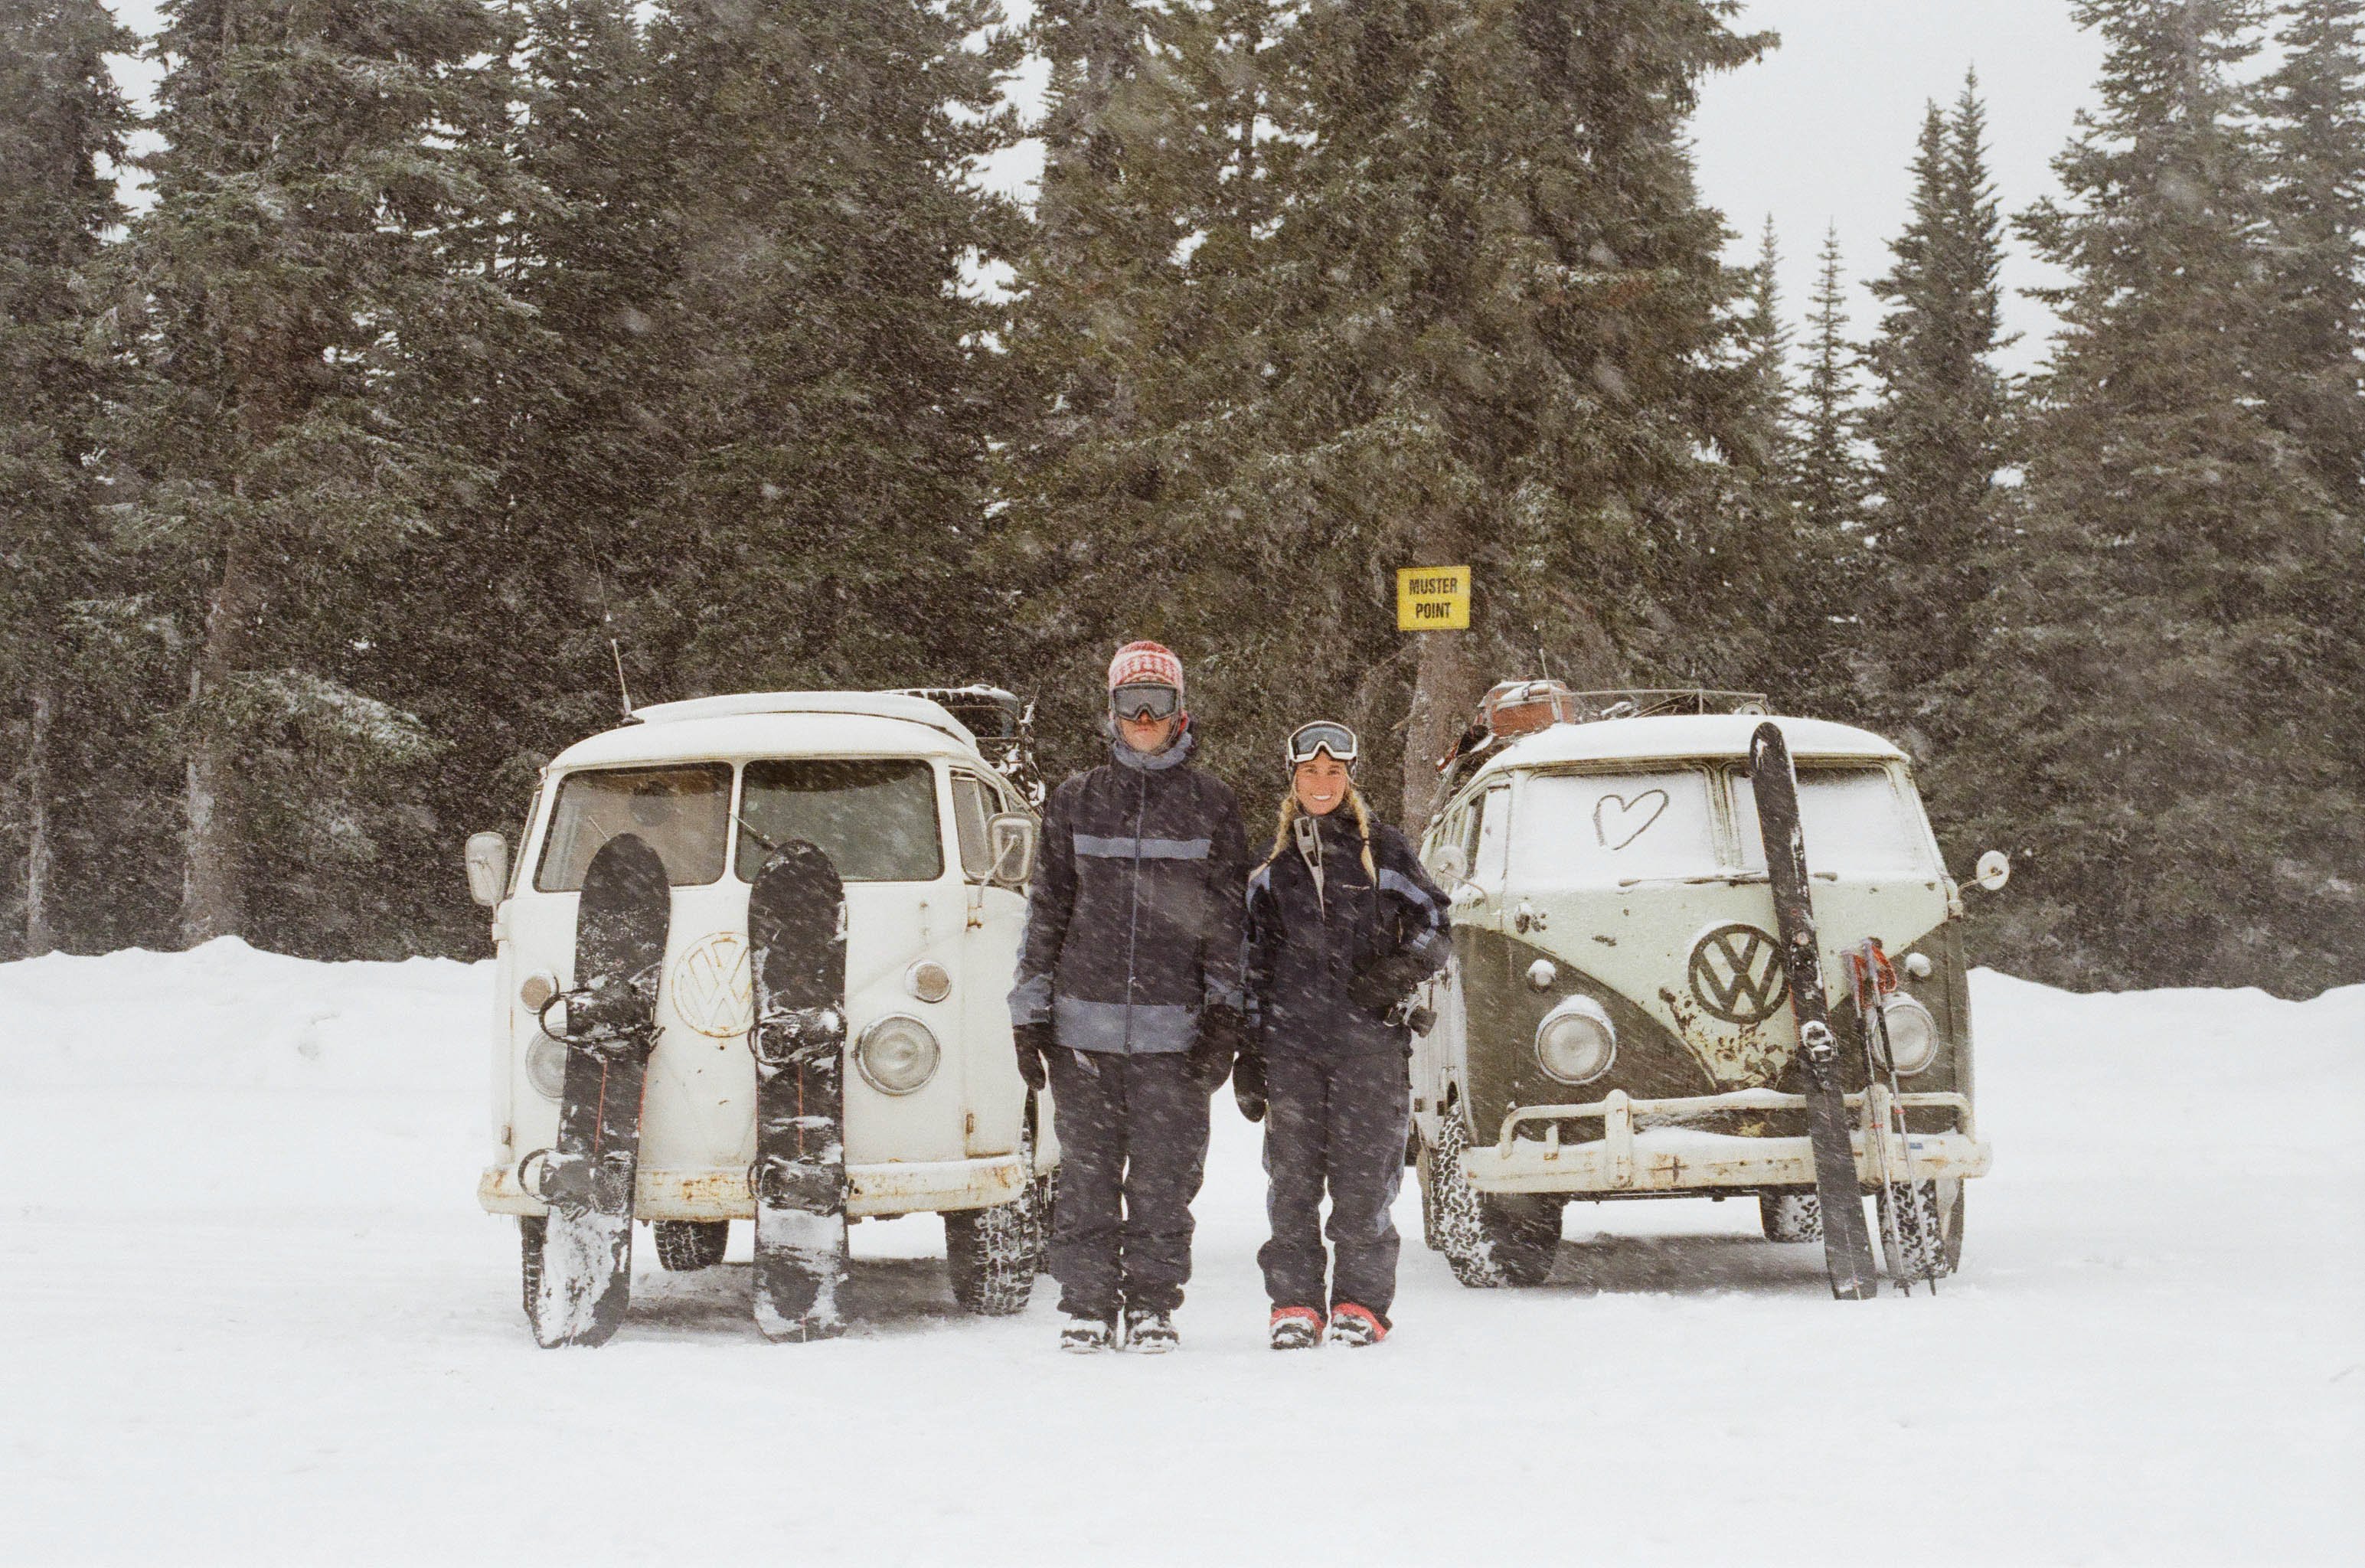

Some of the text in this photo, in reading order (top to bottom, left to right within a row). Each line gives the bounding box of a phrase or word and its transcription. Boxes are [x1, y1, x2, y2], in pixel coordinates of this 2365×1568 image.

[1410, 578, 1458, 594] MUSTER
[1416, 603, 1451, 619] POINT
[1690, 925, 1788, 1023] VW
